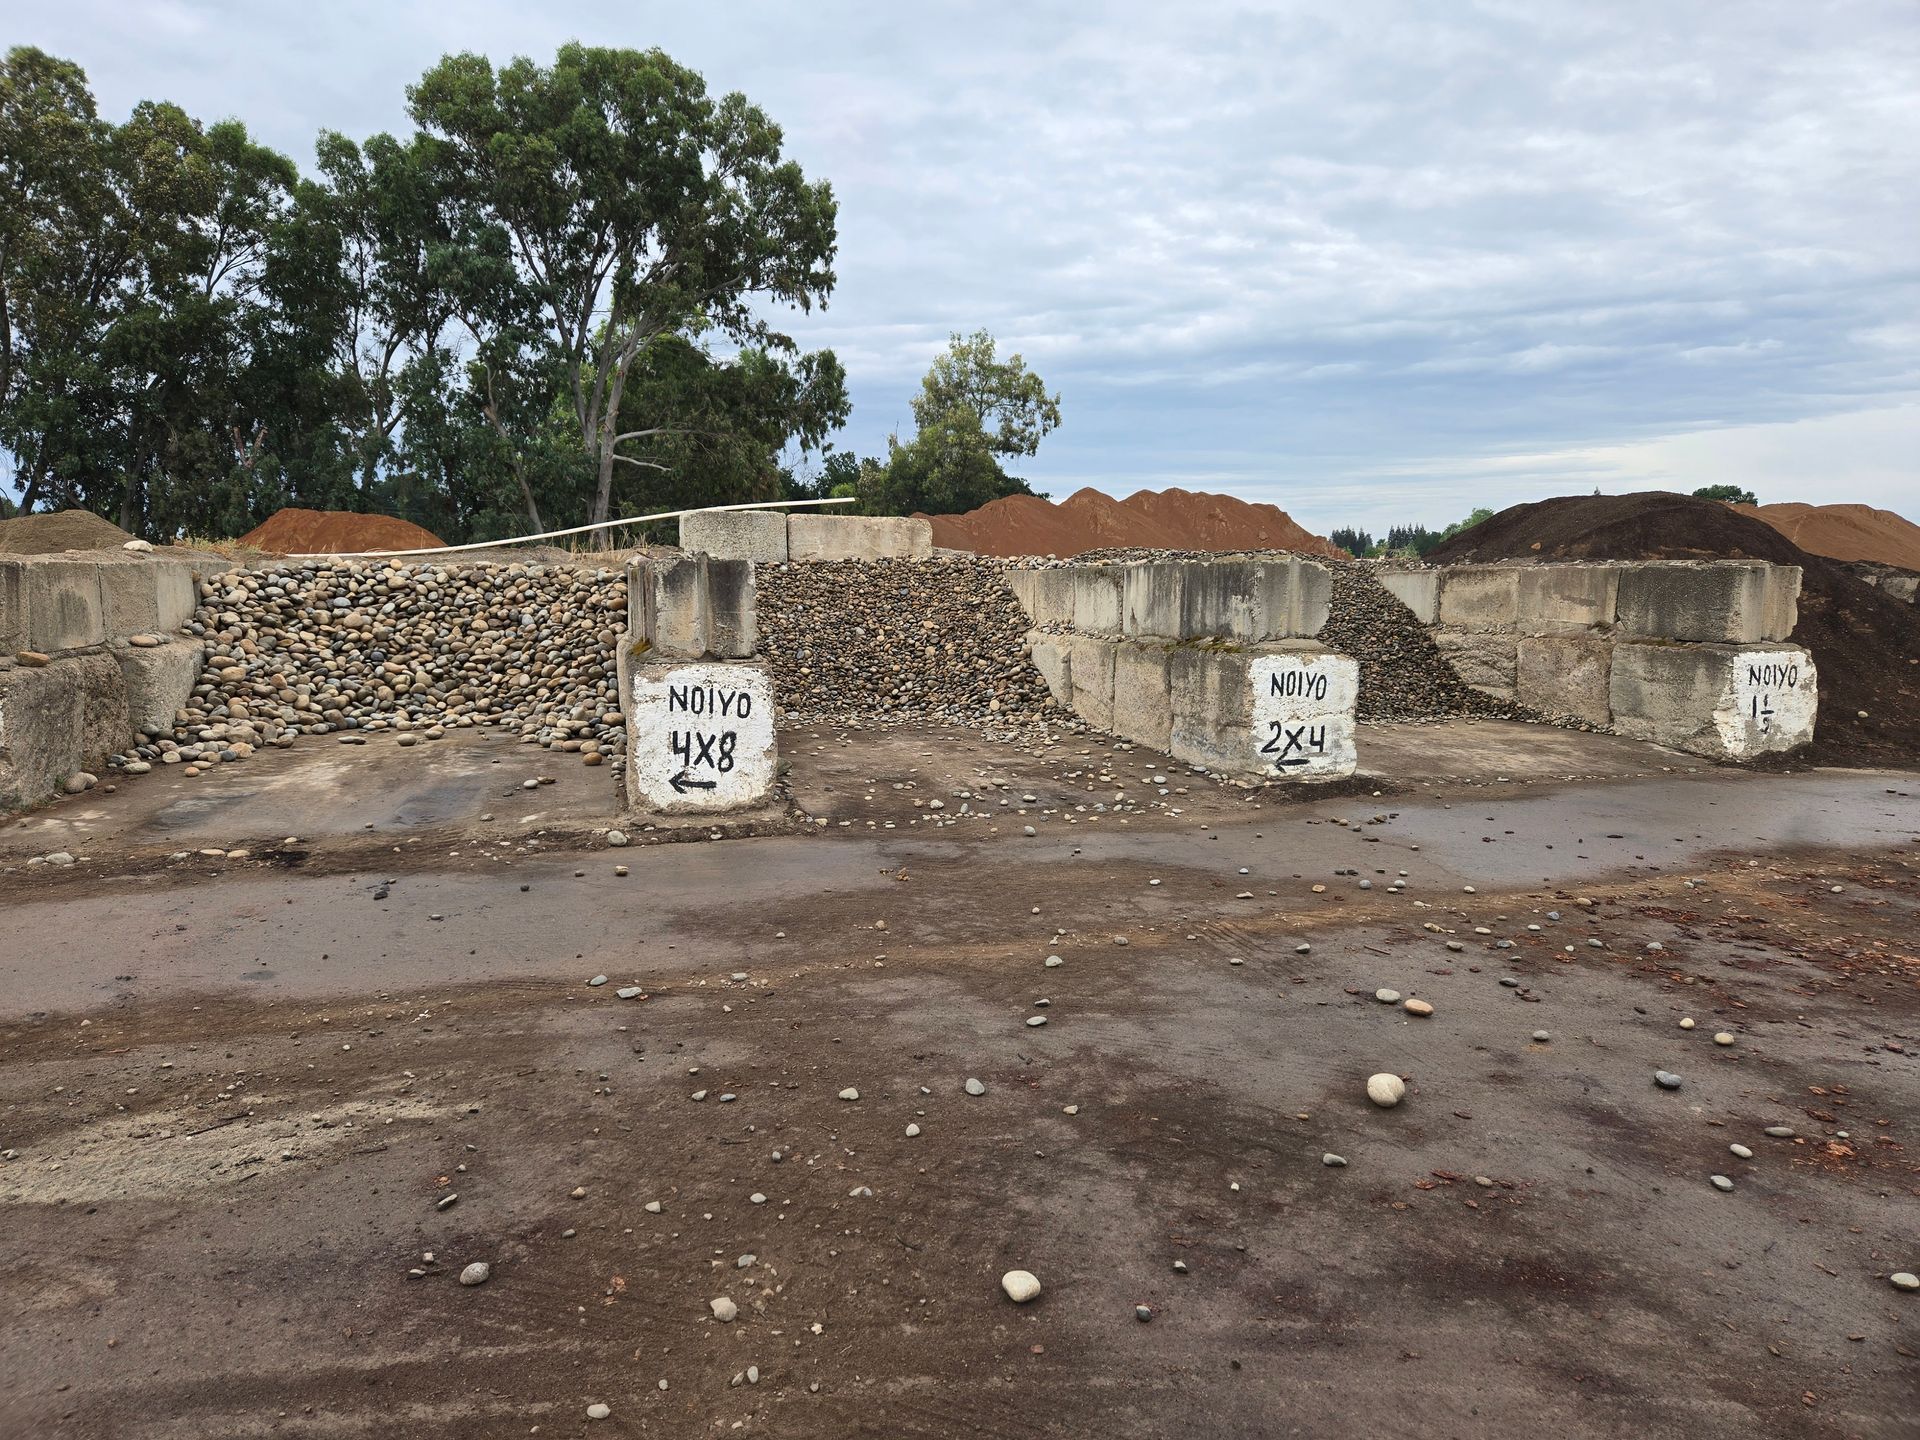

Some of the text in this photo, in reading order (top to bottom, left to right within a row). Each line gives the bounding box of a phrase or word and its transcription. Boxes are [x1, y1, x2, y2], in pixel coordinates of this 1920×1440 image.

[1270, 670, 1327, 701] NOIYO
[1749, 664, 1798, 690] NOIYO
[669, 685, 751, 719] NOIYO
[672, 730, 737, 773] 4X8
